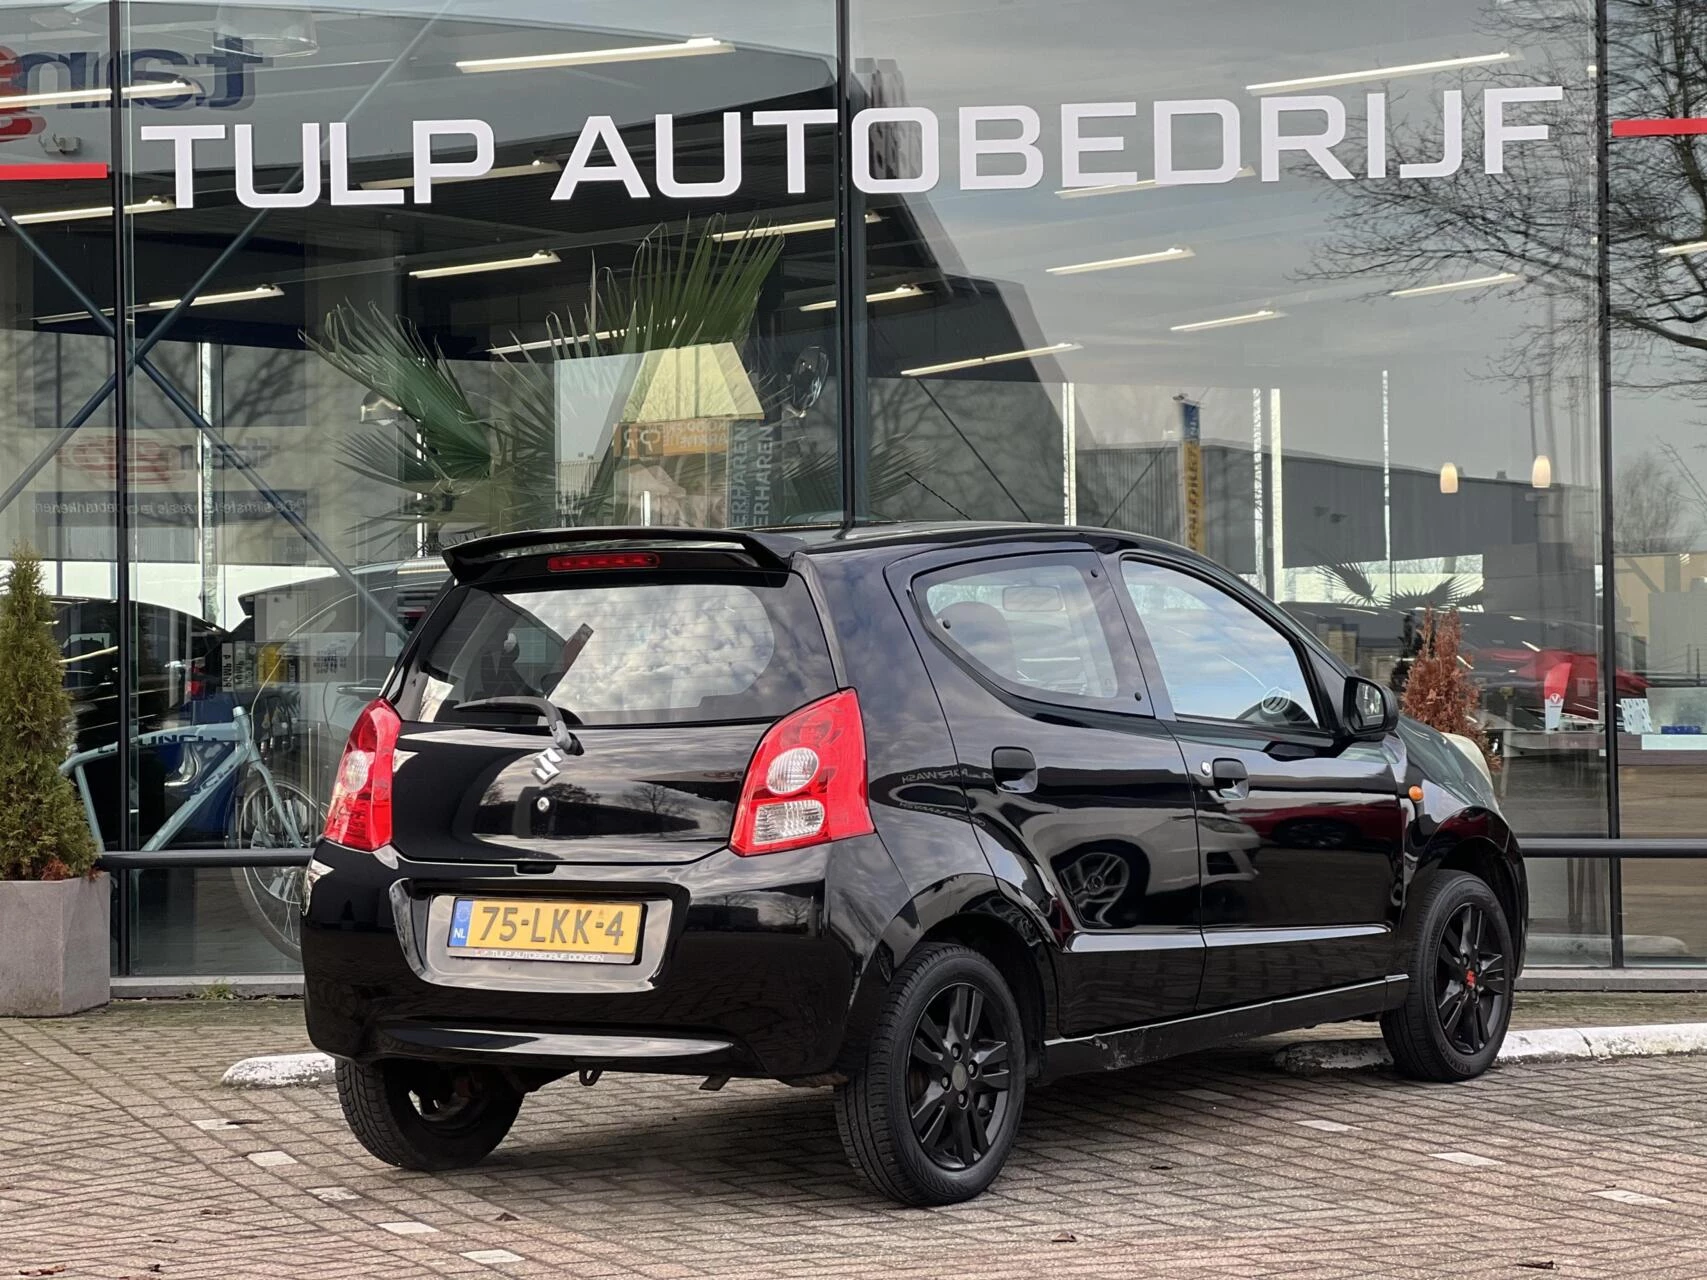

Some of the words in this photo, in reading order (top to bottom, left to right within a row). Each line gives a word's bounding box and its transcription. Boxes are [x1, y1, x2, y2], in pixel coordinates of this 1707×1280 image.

[140, 119, 495, 210] TULP
[551, 85, 1564, 202] AUTOBEDRIJF
[453, 927, 466, 939] NL
[479, 906, 624, 946] 75-LKK-4
